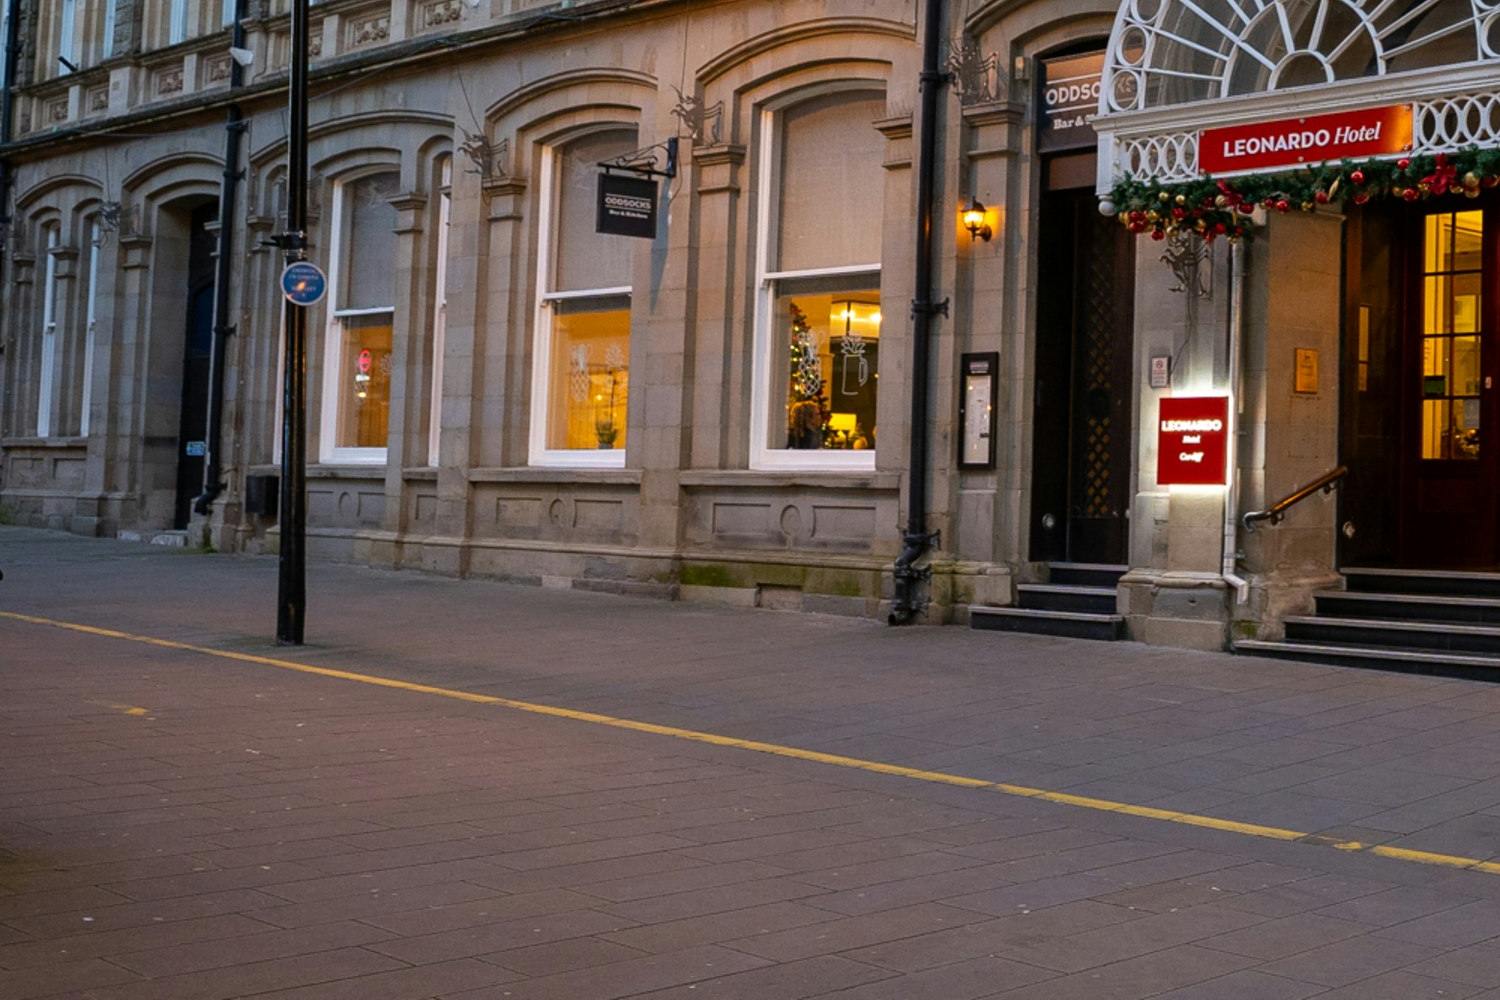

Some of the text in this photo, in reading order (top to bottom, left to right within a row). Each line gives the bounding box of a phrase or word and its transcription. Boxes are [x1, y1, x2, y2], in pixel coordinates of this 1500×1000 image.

[1053, 118, 1074, 131] Bar
[1223, 121, 1382, 158] LEONARDO Hotel
